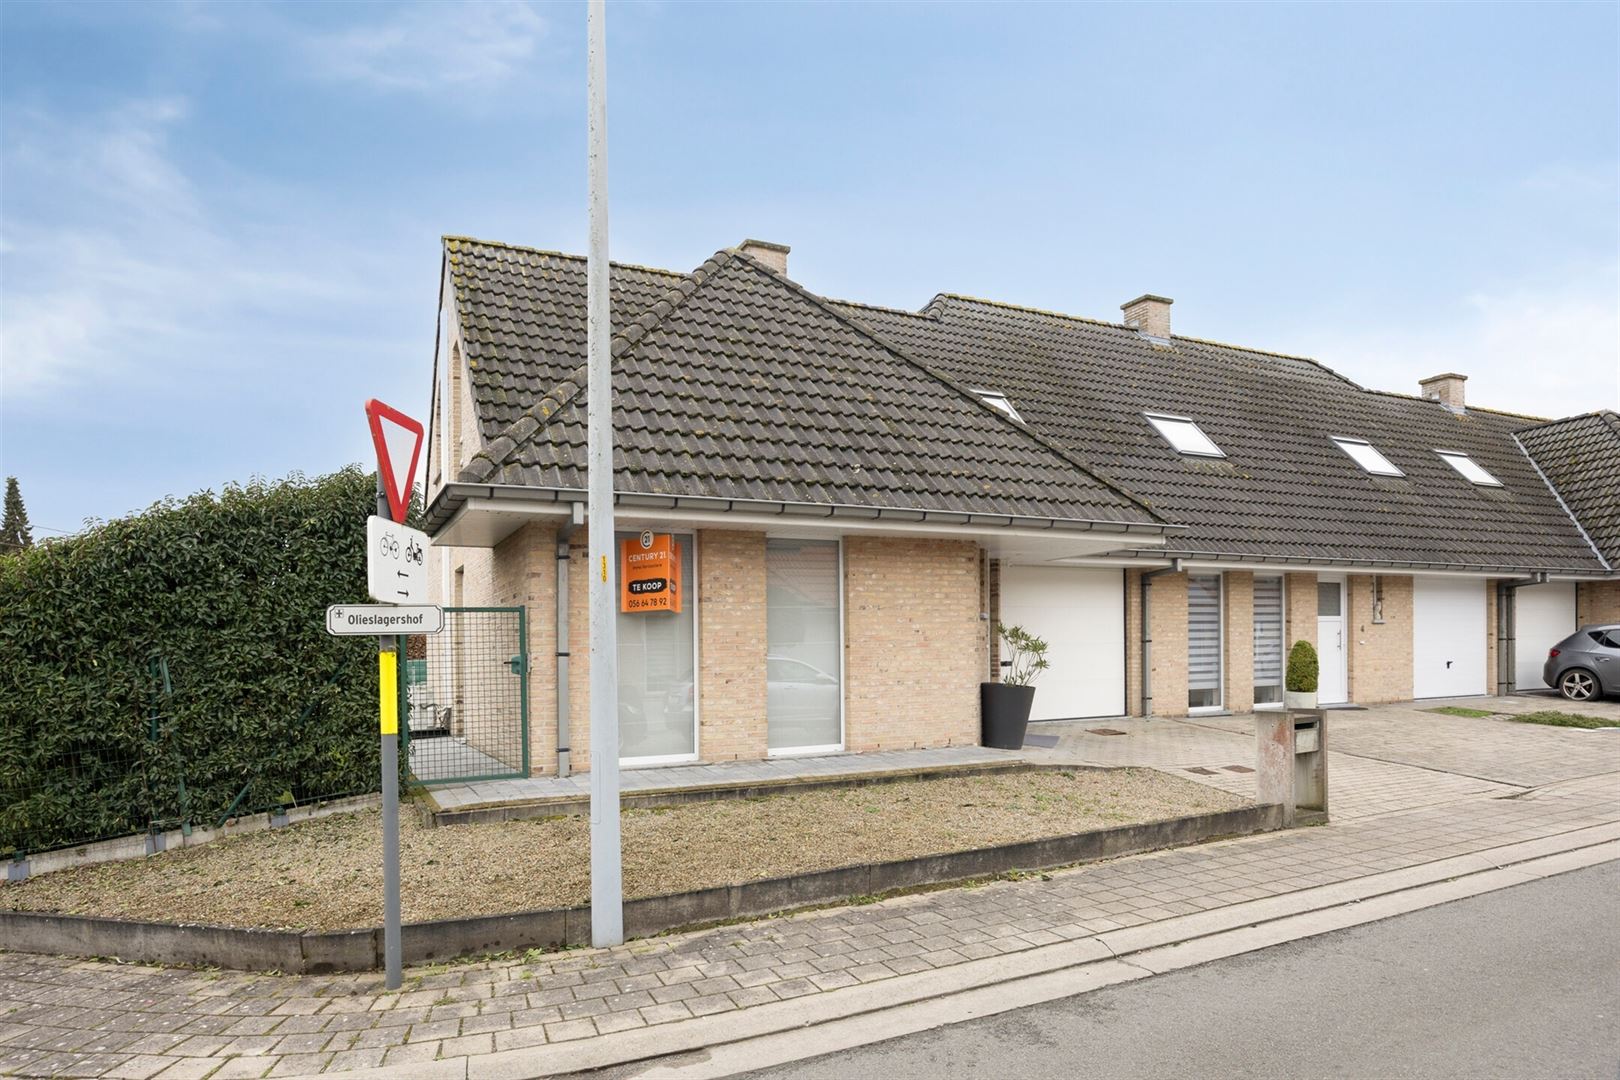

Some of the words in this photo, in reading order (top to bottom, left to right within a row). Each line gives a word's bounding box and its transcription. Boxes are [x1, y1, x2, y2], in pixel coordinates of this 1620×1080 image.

[628, 552, 658, 562] CENTURY
[659, 551, 668, 560] 21
[632, 583, 641, 592] TE
[642, 581, 662, 591] KOOP
[628, 599, 640, 608] 056
[641, 598, 649, 607] 64
[650, 597, 658, 606] 78
[659, 597, 667, 606] 92
[347, 613, 424, 627] Olieslagershof
